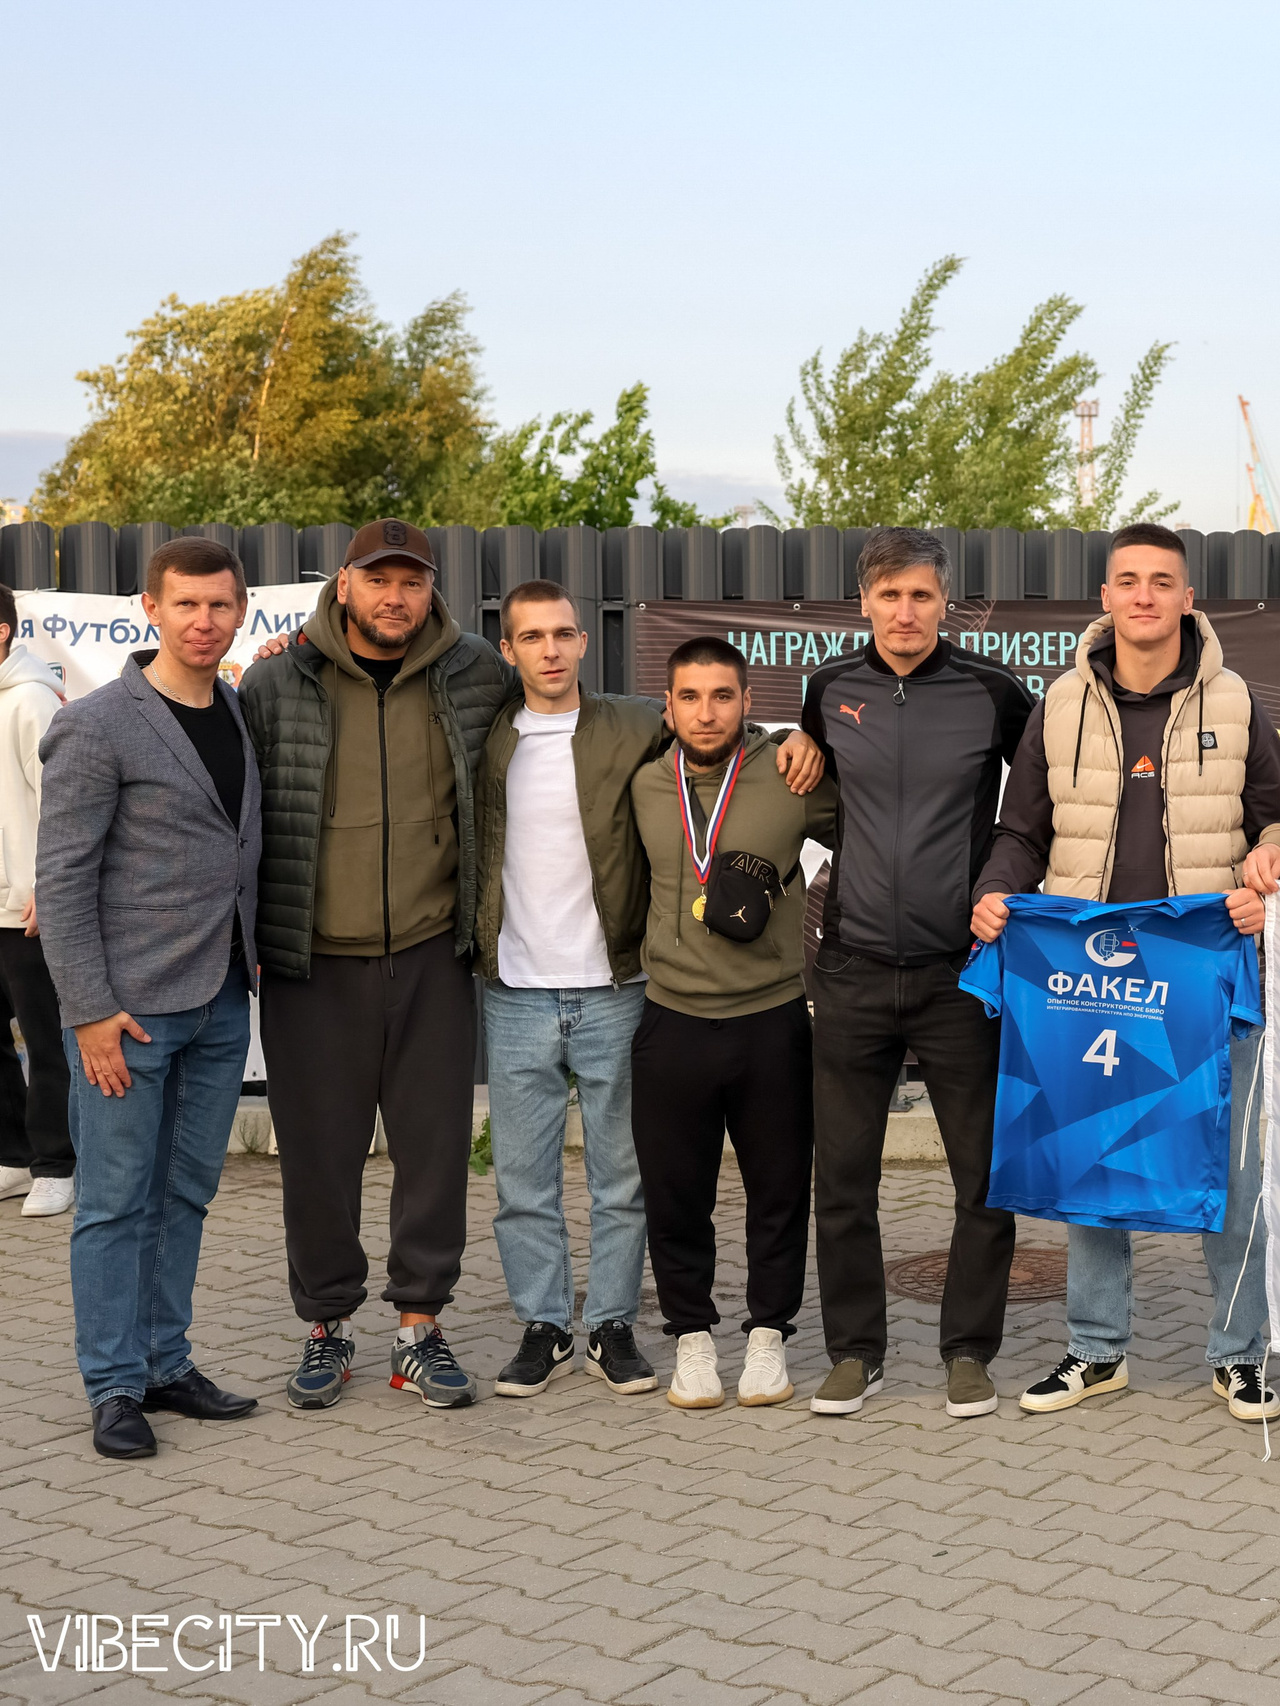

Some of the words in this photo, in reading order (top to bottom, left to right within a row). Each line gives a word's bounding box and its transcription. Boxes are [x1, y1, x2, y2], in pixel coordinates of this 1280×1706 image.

[727, 631, 948, 666] НАГРАЖ
[960, 631, 1085, 666] ПРИЗЕР
[730, 853, 773, 884] AIR
[1047, 971, 1169, 1006] ФАКЕЛ
[1046, 998, 1080, 1006] ОПЫТНОЕ
[1080, 1000, 1145, 1013] КОНСТРУКТОРСКОЕ
[1145, 1007, 1165, 1015] БЮРО
[1082, 1029, 1120, 1077] 4
